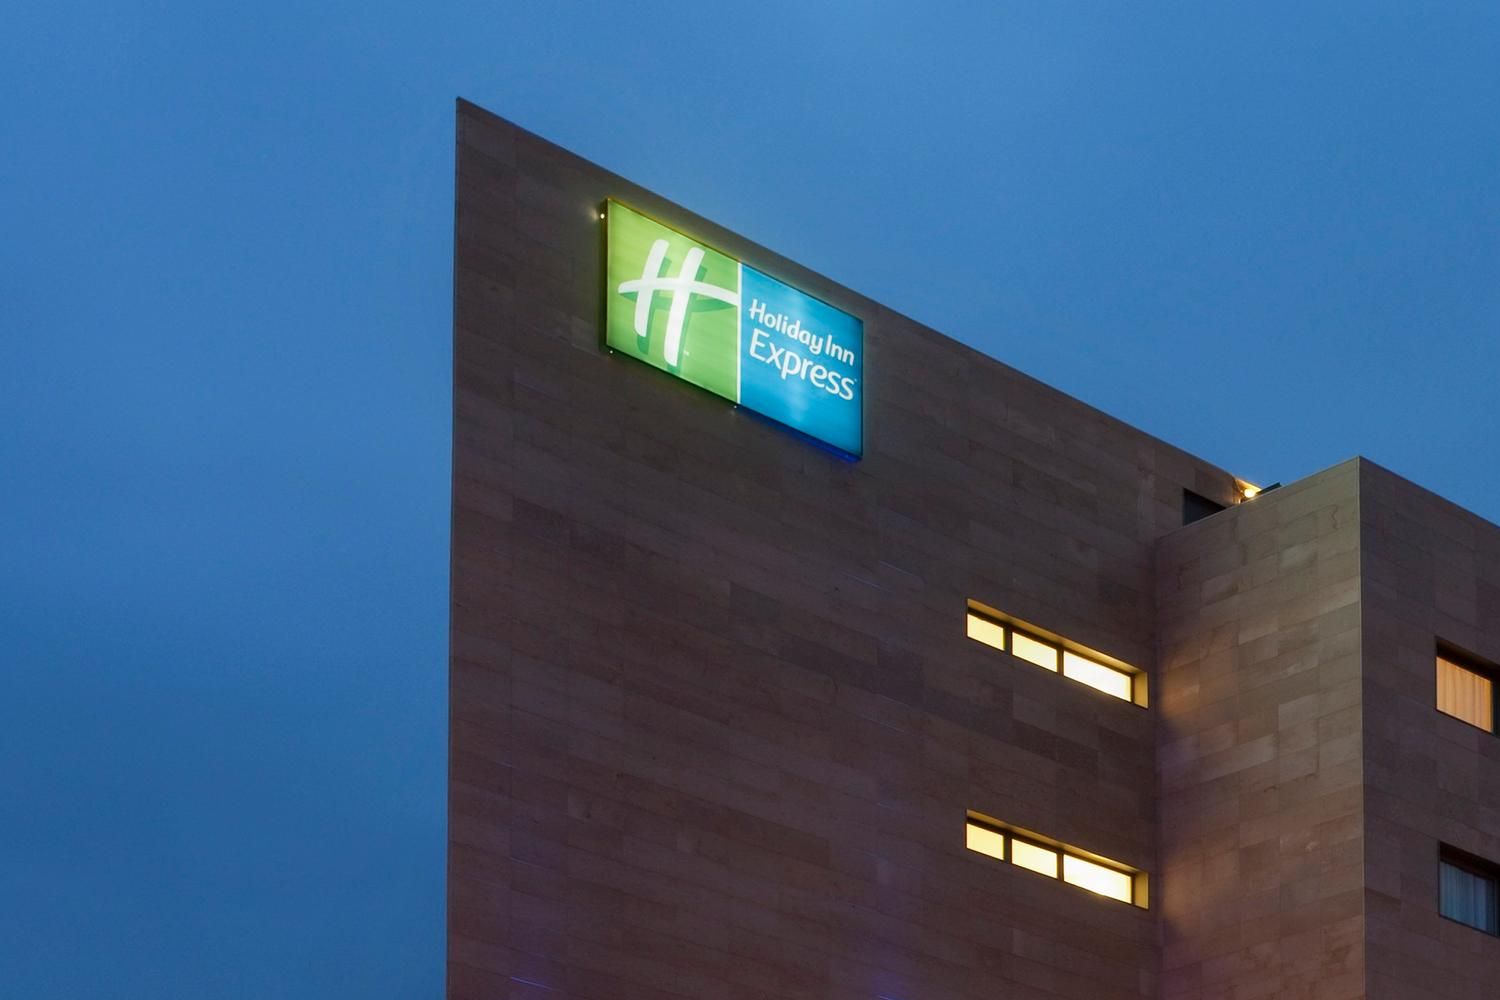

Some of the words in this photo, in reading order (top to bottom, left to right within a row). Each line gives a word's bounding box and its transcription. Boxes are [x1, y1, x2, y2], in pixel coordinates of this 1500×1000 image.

[749, 299, 823, 355] Holiday
[825, 334, 855, 366] Inn
[749, 328, 855, 400] Express
